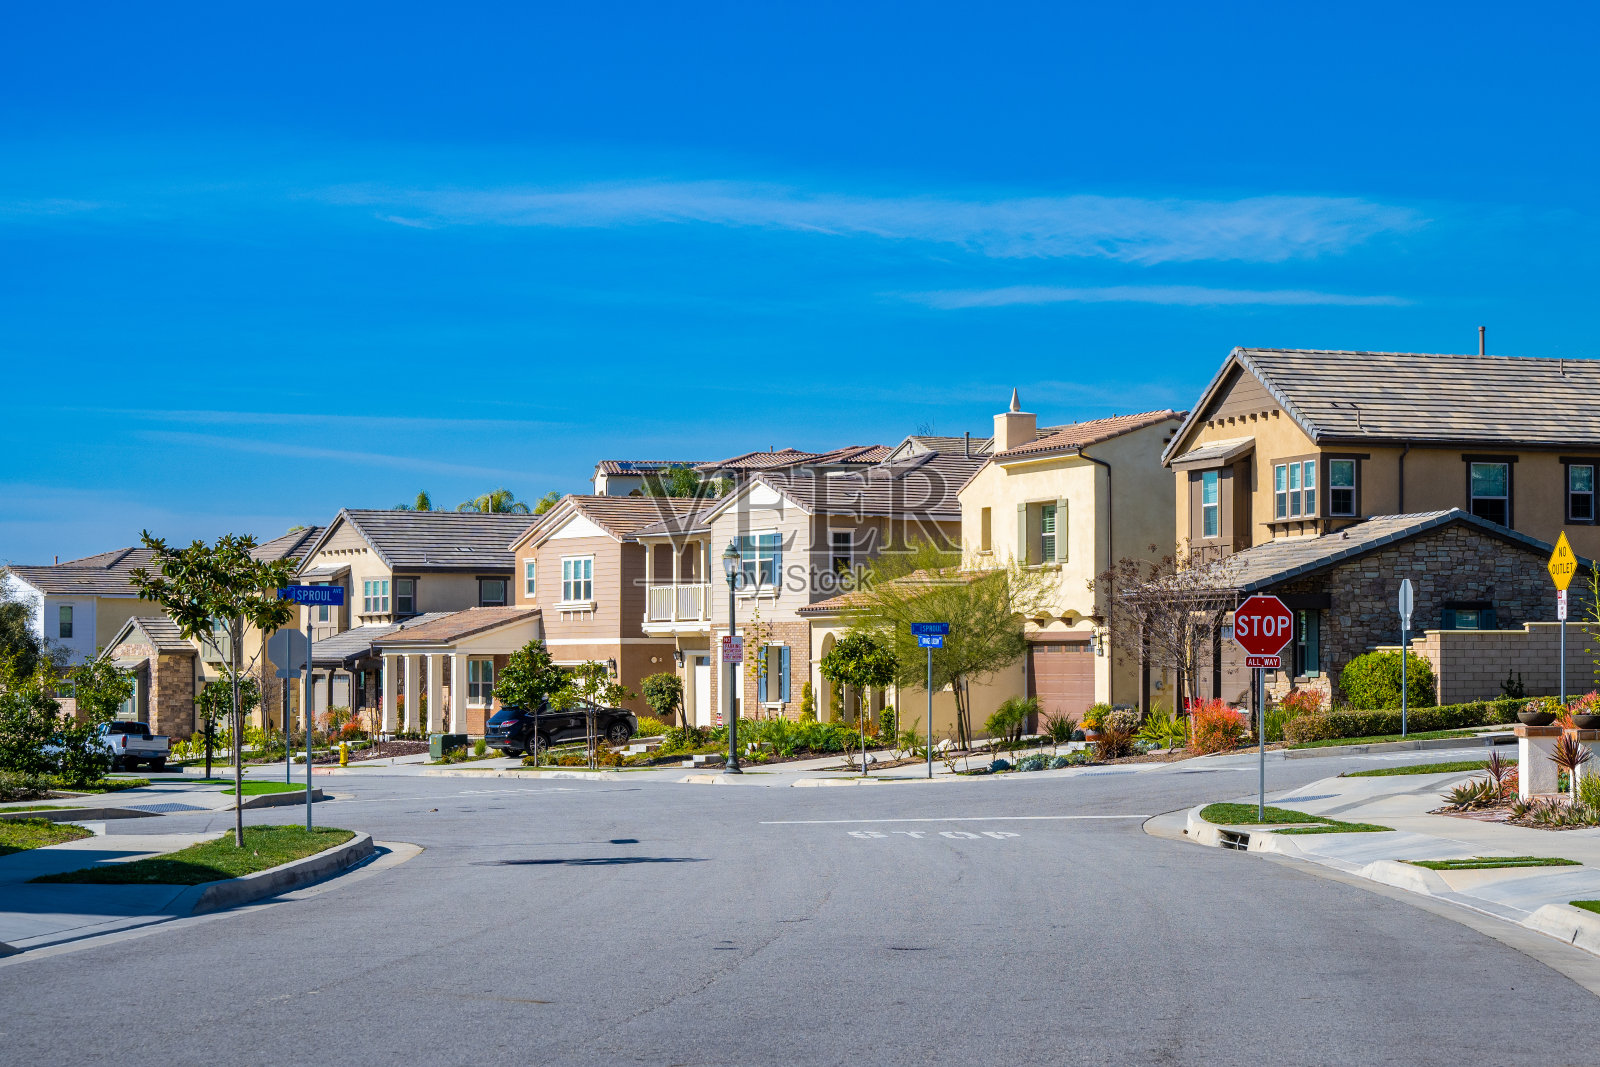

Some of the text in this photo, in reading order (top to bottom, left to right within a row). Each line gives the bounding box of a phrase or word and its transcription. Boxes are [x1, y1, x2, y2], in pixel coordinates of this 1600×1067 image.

[1558, 546, 1567, 558] NO
[1551, 562, 1573, 575] OUTLET
[296, 590, 332, 602] SPROUL
[922, 624, 943, 633] SPROUL
[1236, 615, 1290, 637] STOP
[1248, 658, 1278, 666] ALL WAY
[847, 831, 1021, 840] STOP
